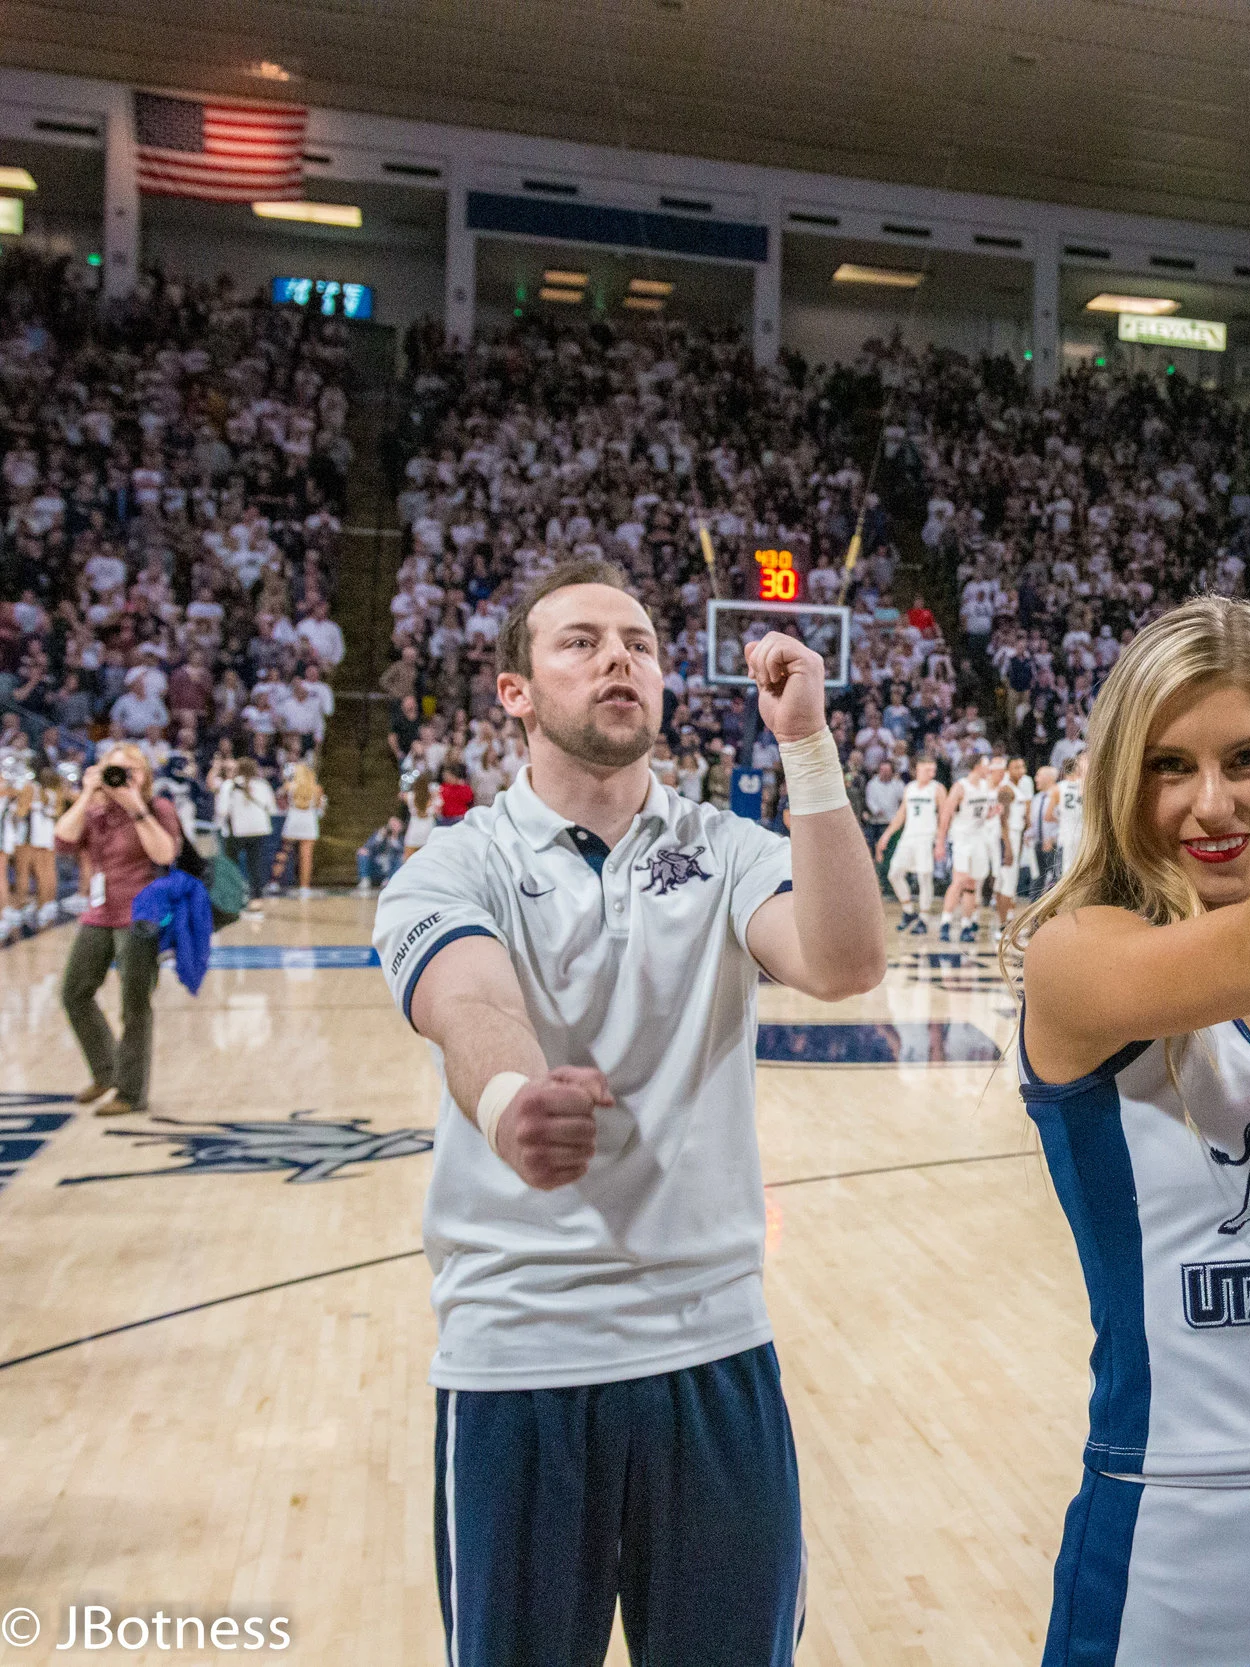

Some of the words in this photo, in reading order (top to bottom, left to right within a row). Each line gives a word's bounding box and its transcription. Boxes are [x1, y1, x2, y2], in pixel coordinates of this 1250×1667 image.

[761, 568, 796, 600] 30
[391, 942, 410, 976] UTAH
[406, 911, 443, 945] STATE
